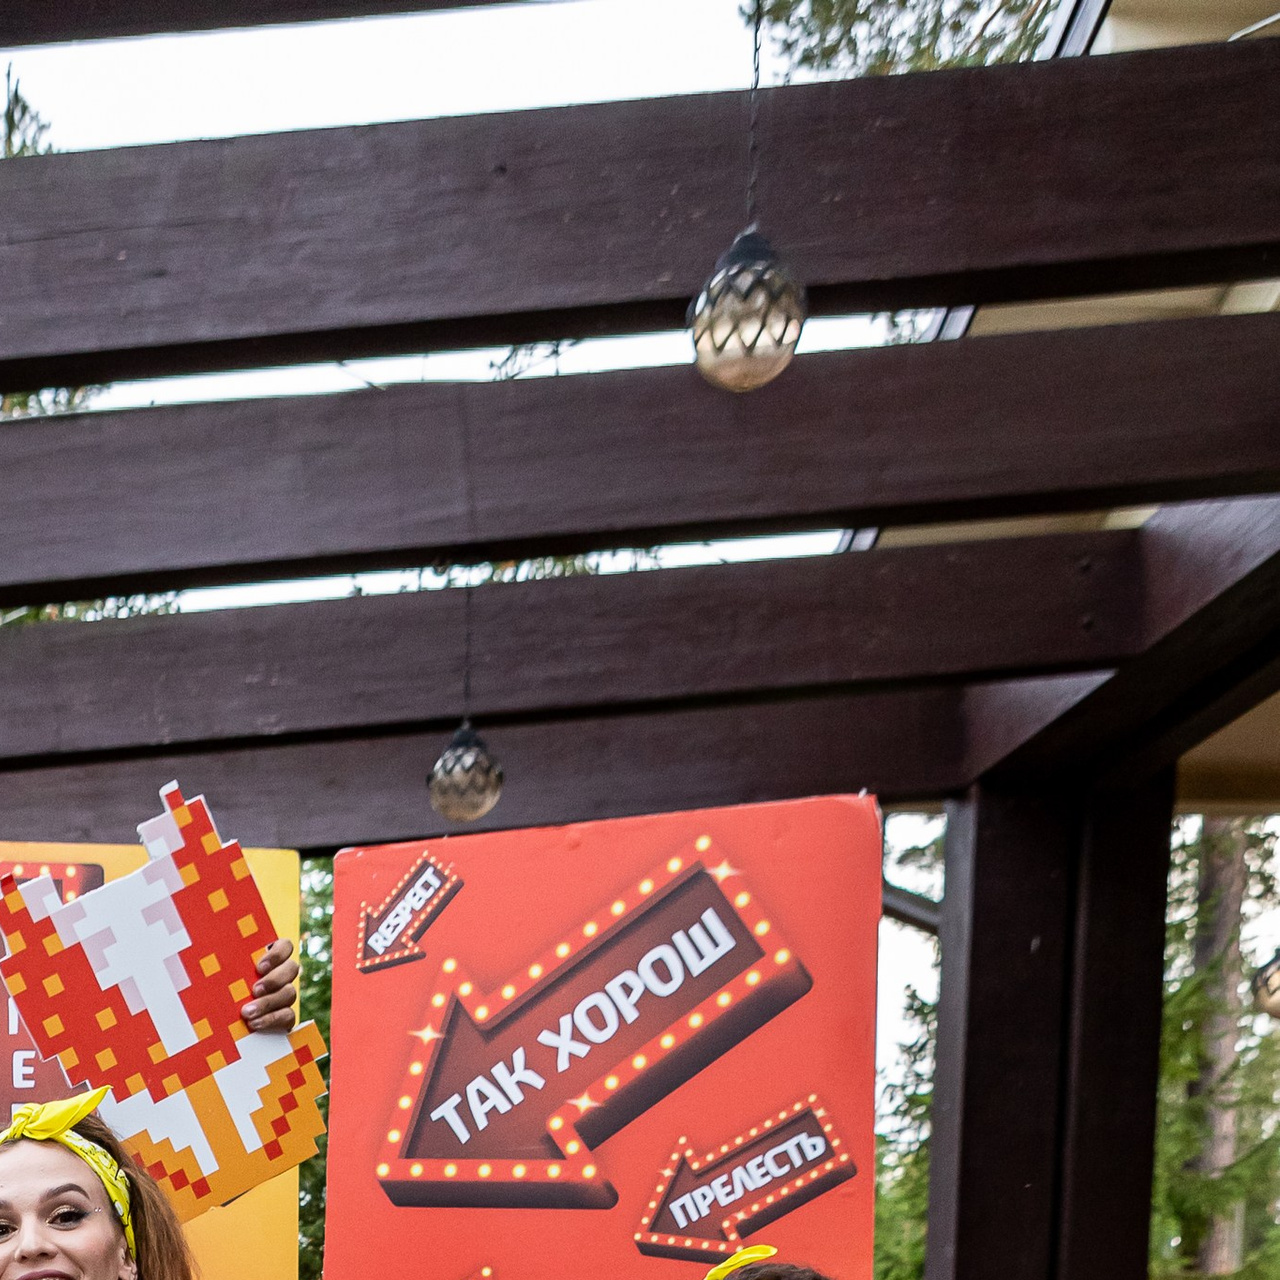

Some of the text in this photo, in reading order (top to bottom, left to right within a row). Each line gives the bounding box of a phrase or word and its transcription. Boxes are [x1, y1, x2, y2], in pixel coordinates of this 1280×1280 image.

[366, 866, 444, 957] RESPECT
[429, 908, 737, 1145] ТАК ХОРОШ
[668, 1132, 827, 1230] ПРЕЛЕСТЬ
